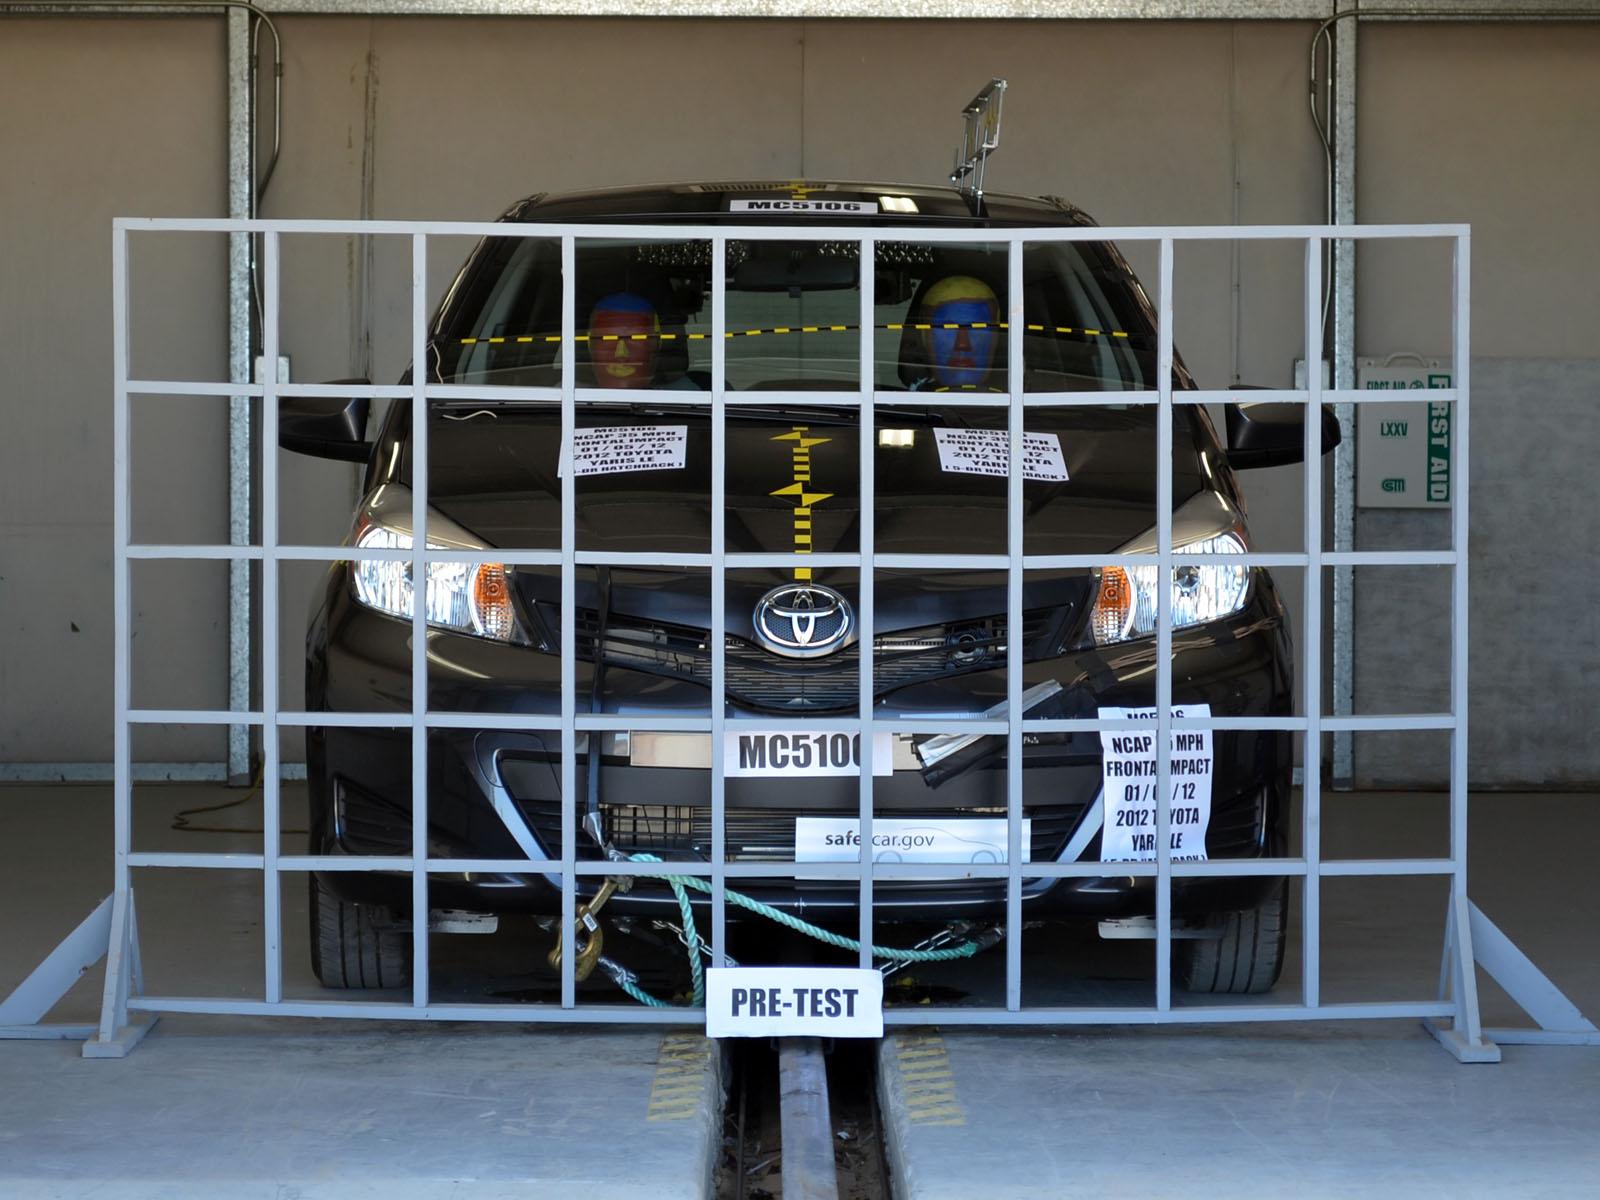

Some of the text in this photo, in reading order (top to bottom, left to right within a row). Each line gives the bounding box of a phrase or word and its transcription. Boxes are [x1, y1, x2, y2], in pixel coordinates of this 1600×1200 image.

[748, 201, 861, 211] MC5106
[1380, 422, 1408, 437] LXXV
[1431, 377, 1449, 500] FRST AID
[615, 449, 673, 457] TOYOTA
[1004, 442, 1059, 452] IPACT
[590, 457, 635, 466] YARIS
[601, 462, 675, 472] HATCHBACK
[1112, 736, 1152, 754] NCAP
[1176, 733, 1204, 751] MPH
[1106, 758, 1211, 776] FRONTA MPACT
[1125, 784, 1140, 801] 01
[1142, 784, 1150, 801] /
[1182, 782, 1196, 800] 12
[1116, 808, 1200, 827] 2012 TYOTA
[1170, 833, 1183, 849] LE
[731, 988, 859, 1018] PRE-TEST
